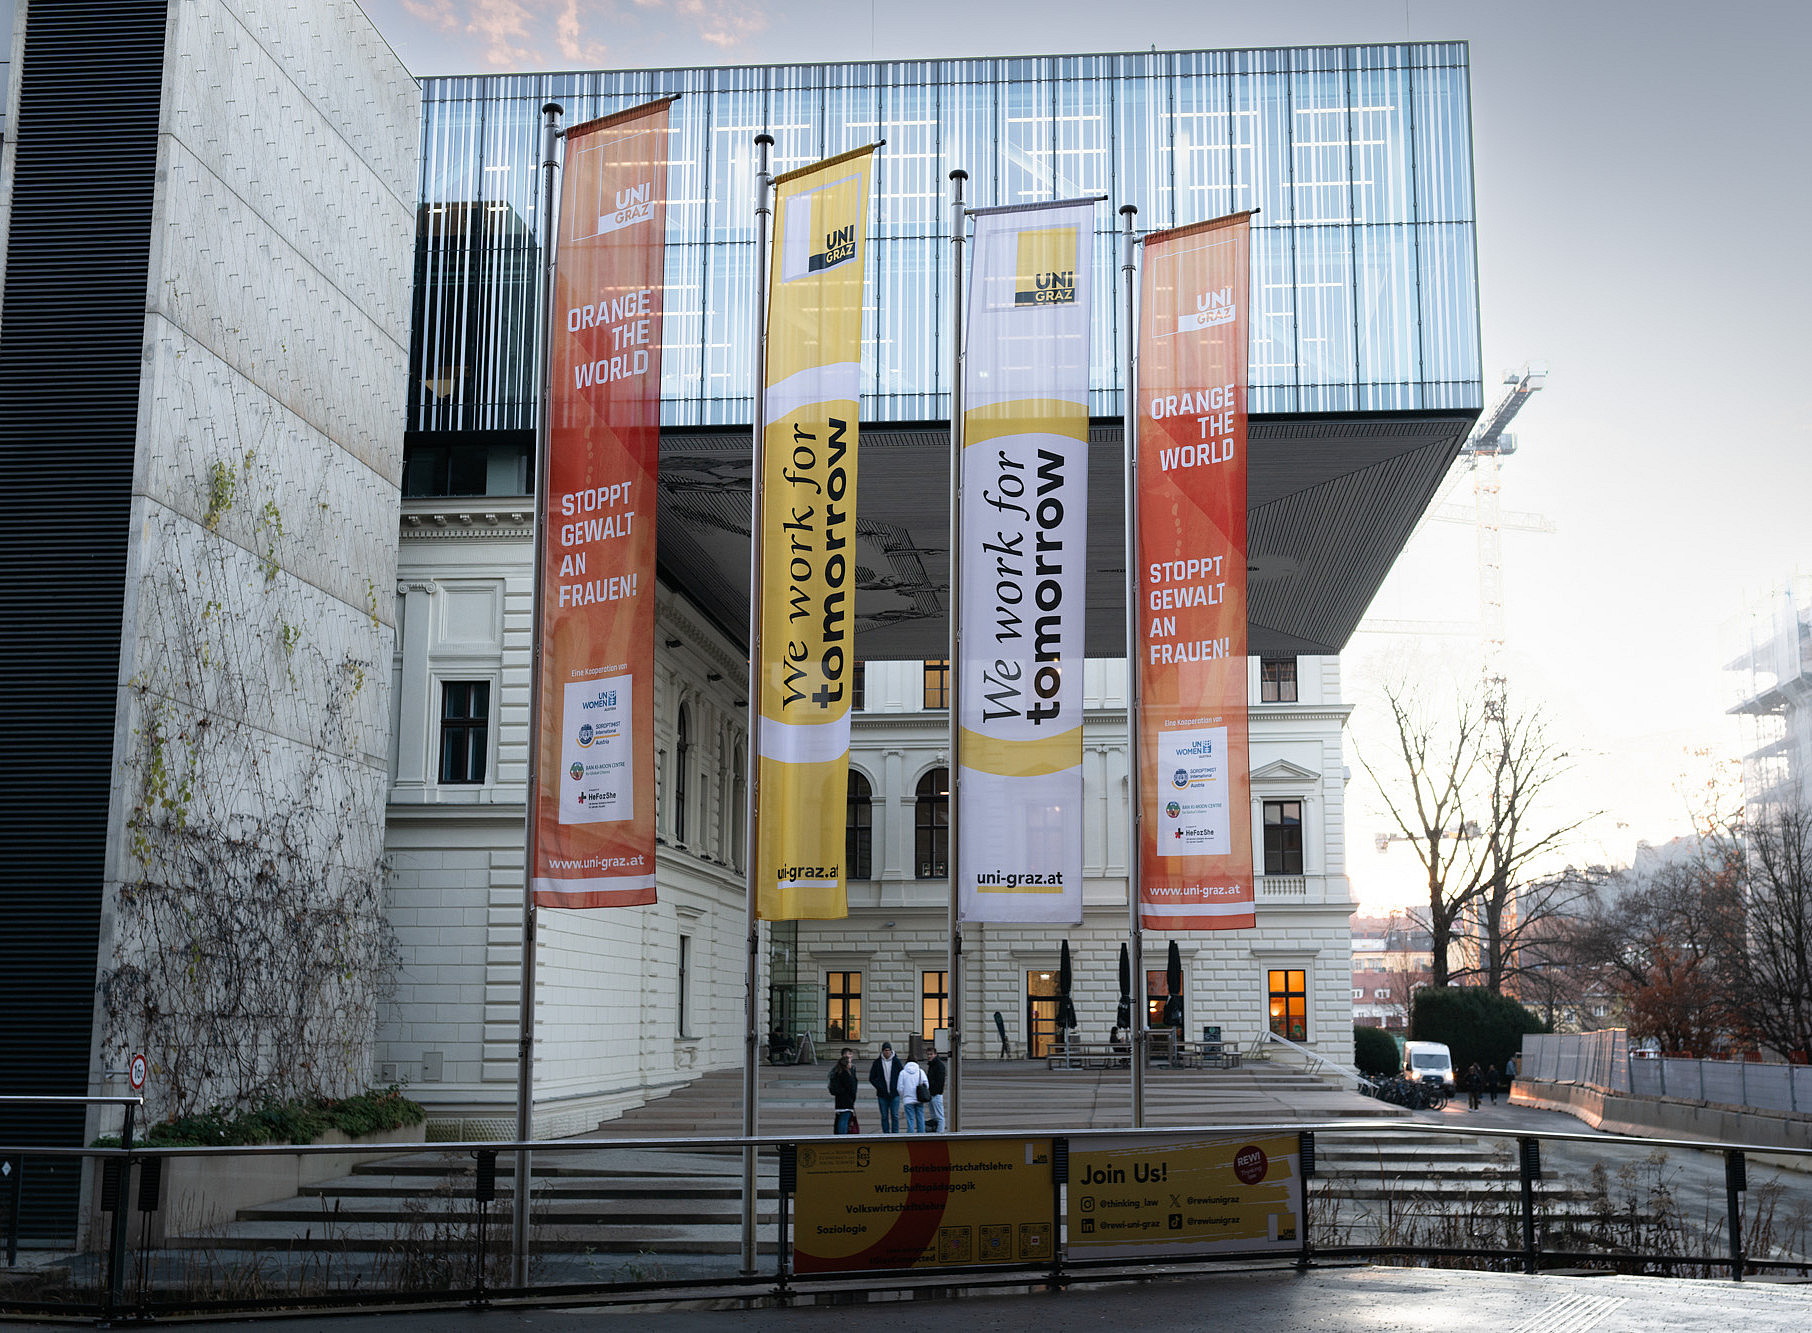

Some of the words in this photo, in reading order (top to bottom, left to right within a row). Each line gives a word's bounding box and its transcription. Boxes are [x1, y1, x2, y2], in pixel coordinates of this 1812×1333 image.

[615, 182, 650, 210] UNI
[615, 203, 649, 224] GRAZ
[826, 224, 854, 250] UNI
[826, 244, 853, 263] GRAZ
[1035, 271, 1073, 289] UNI
[1035, 289, 1072, 301] GRAZ
[1196, 287, 1232, 311] UNI
[567, 289, 651, 332] ORANGE
[1197, 307, 1231, 325] GRAZ
[612, 319, 650, 351] THE
[575, 349, 649, 390] WORLD
[1151, 383, 1235, 420] ORANGE
[1197, 411, 1235, 439] THE
[783, 423, 821, 495] for
[1159, 438, 1234, 471] WORLD
[983, 450, 1030, 522] for
[561, 481, 632, 516] STOPPT
[561, 512, 635, 547] GEWALT
[559, 552, 586, 577] AN
[783, 505, 815, 624] work
[812, 417, 847, 708] tomorrow
[1150, 555, 1223, 584] STOPPT
[558, 573, 638, 608] FRAUEN!
[982, 531, 1024, 643] work
[1026, 448, 1065, 725] tomorrow
[1150, 582, 1226, 611] GEWALT
[1149, 616, 1176, 638] AN
[1150, 637, 1230, 665] FRAUEN!
[571, 669, 584, 677] Eine
[782, 640, 808, 711] We
[598, 691, 608, 700] UN
[983, 659, 1021, 723] We
[582, 700, 608, 709] WOMEN
[1164, 719, 1176, 727] Eine
[1176, 747, 1202, 756] WOMEN
[588, 792, 616, 800] HeForShe
[549, 855, 645, 871] www.uni-graz.at
[977, 869, 1063, 888] uni-graz.at
[1149, 884, 1241, 898] www.uni-graz.at
[903, 1162, 1013, 1173] Betriebswirtschaftslehre
[1237, 1152, 1260, 1167] REWI
[1080, 1164, 1125, 1185] Join
[1134, 1162, 1168, 1183] Us!
[846, 1203, 946, 1214] Volkswirtschaftslehre
[1100, 1198, 1159, 1209] @thinking_law
[1187, 1195, 1240, 1206] @rewiunigraz
[816, 1224, 867, 1236] Soziologie
[1187, 1216, 1240, 1226] @rewiunigraz
